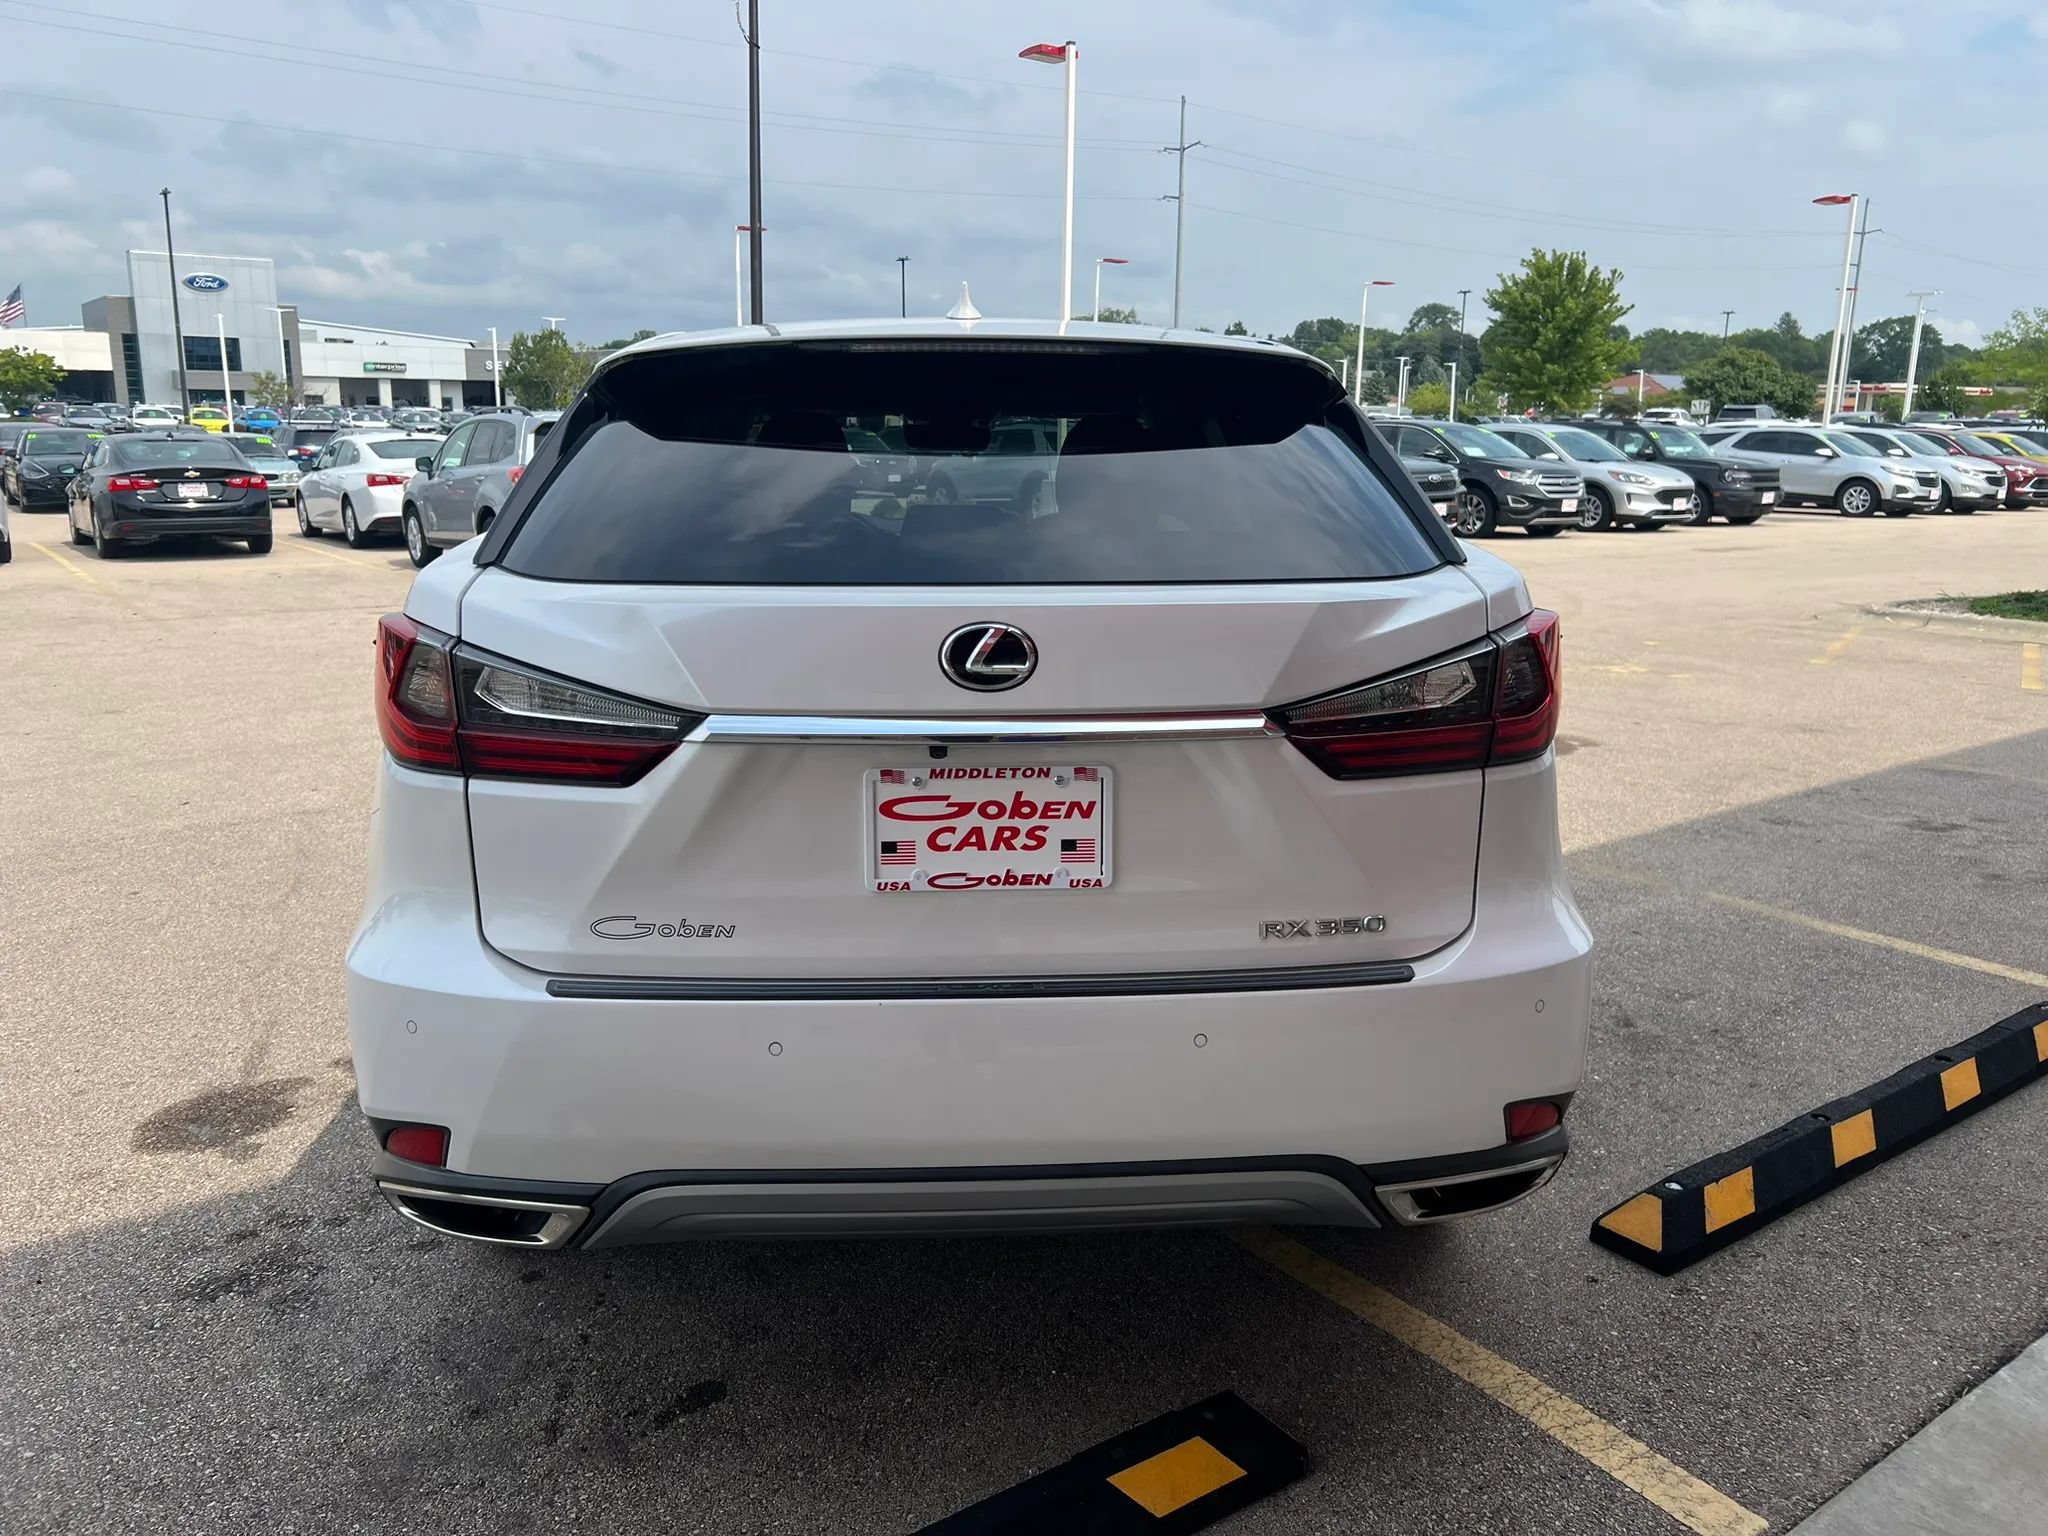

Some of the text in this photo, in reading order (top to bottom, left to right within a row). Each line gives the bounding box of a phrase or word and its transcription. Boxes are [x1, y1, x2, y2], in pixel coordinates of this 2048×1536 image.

[193, 277, 219, 288] Ford
[929, 767, 1051, 780] MIDDLETON
[926, 825, 1050, 852] CARS
[876, 881, 911, 891] USA
[1069, 878, 1103, 888] USA
[1258, 915, 1386, 940] RX 350
